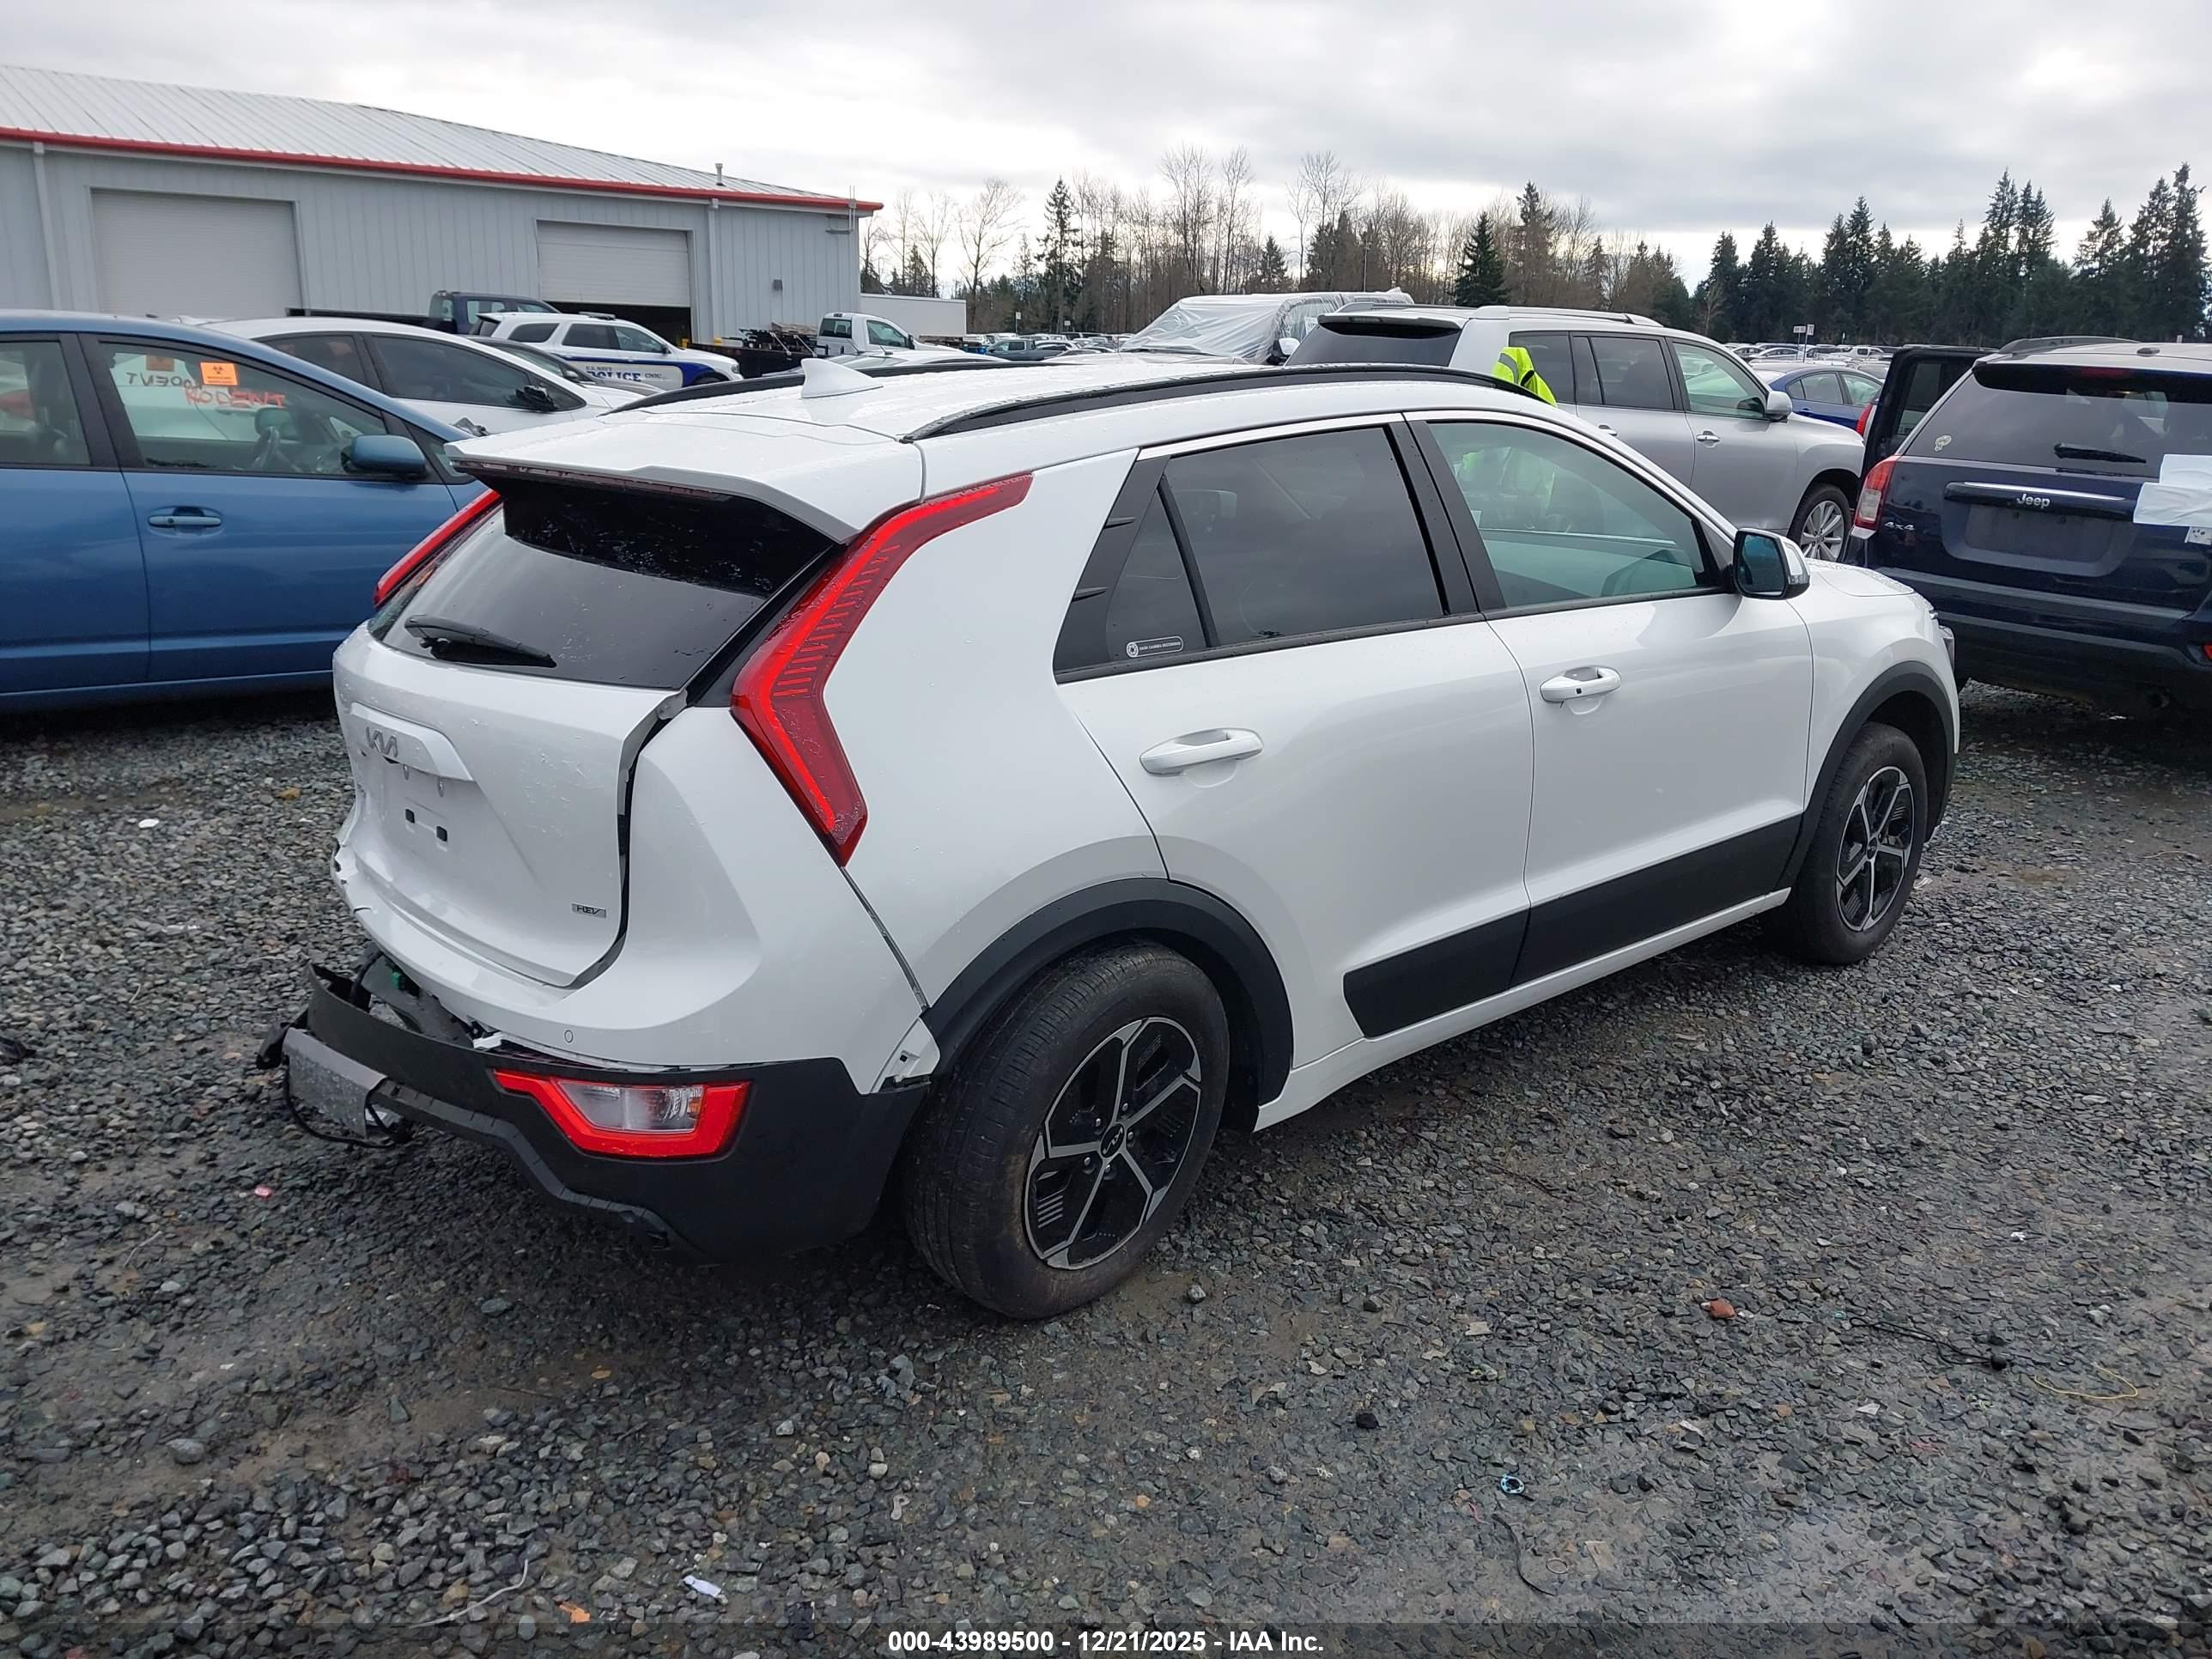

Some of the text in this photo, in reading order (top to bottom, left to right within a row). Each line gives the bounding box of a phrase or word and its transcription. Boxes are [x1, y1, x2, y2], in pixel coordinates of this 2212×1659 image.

[185, 388, 285, 409] RODENT
[2017, 493, 2051, 509] Jeep
[576, 904, 601, 915] HEV
